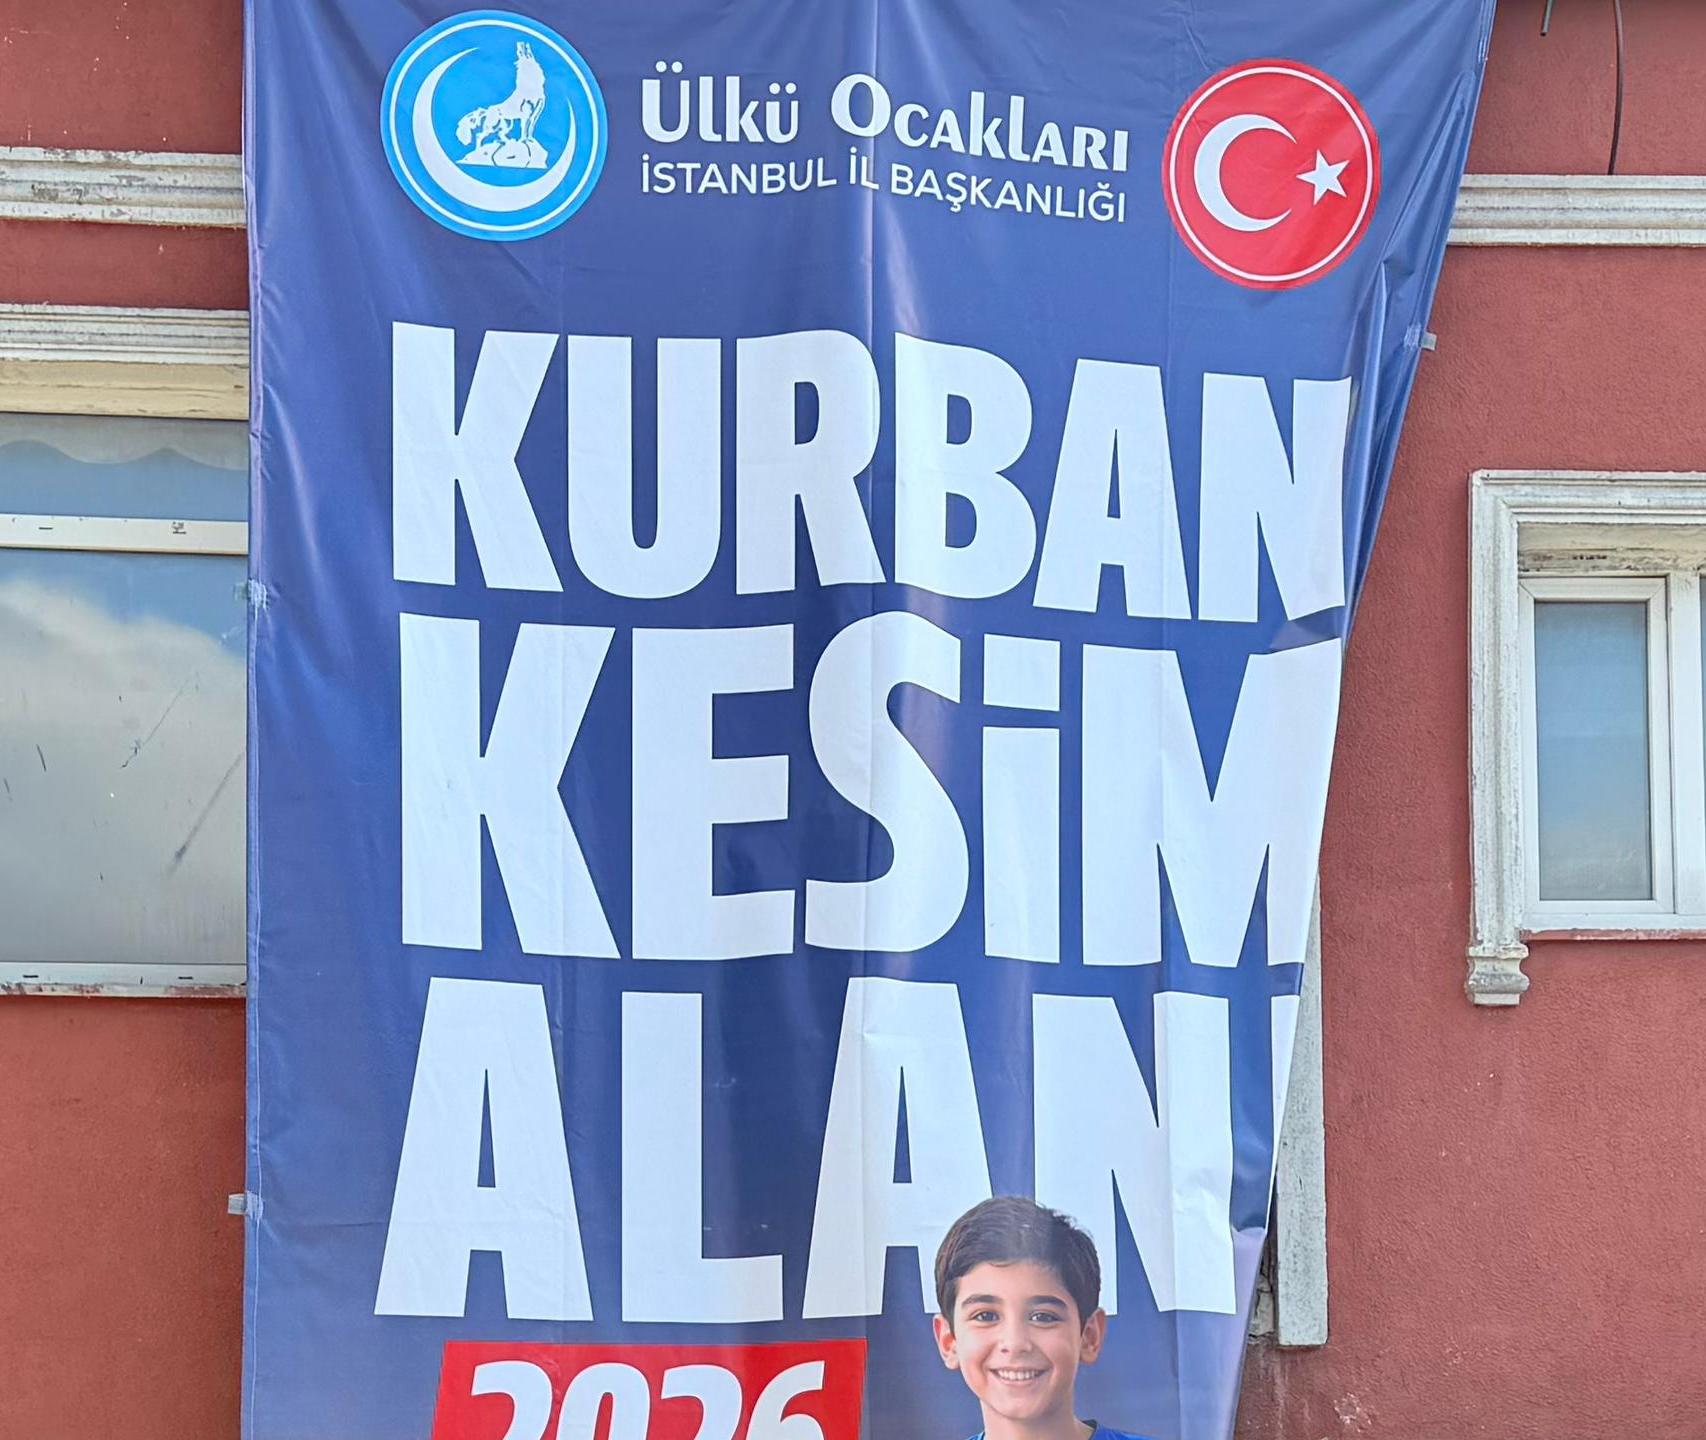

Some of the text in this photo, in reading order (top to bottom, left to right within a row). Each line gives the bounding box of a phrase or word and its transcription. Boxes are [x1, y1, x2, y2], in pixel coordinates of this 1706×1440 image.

[641, 60, 799, 143] Ülkü
[642, 146, 1126, 223] İSTANBUL İL BAŞKANLIĞI
[393, 321, 1352, 623] KURBAN
